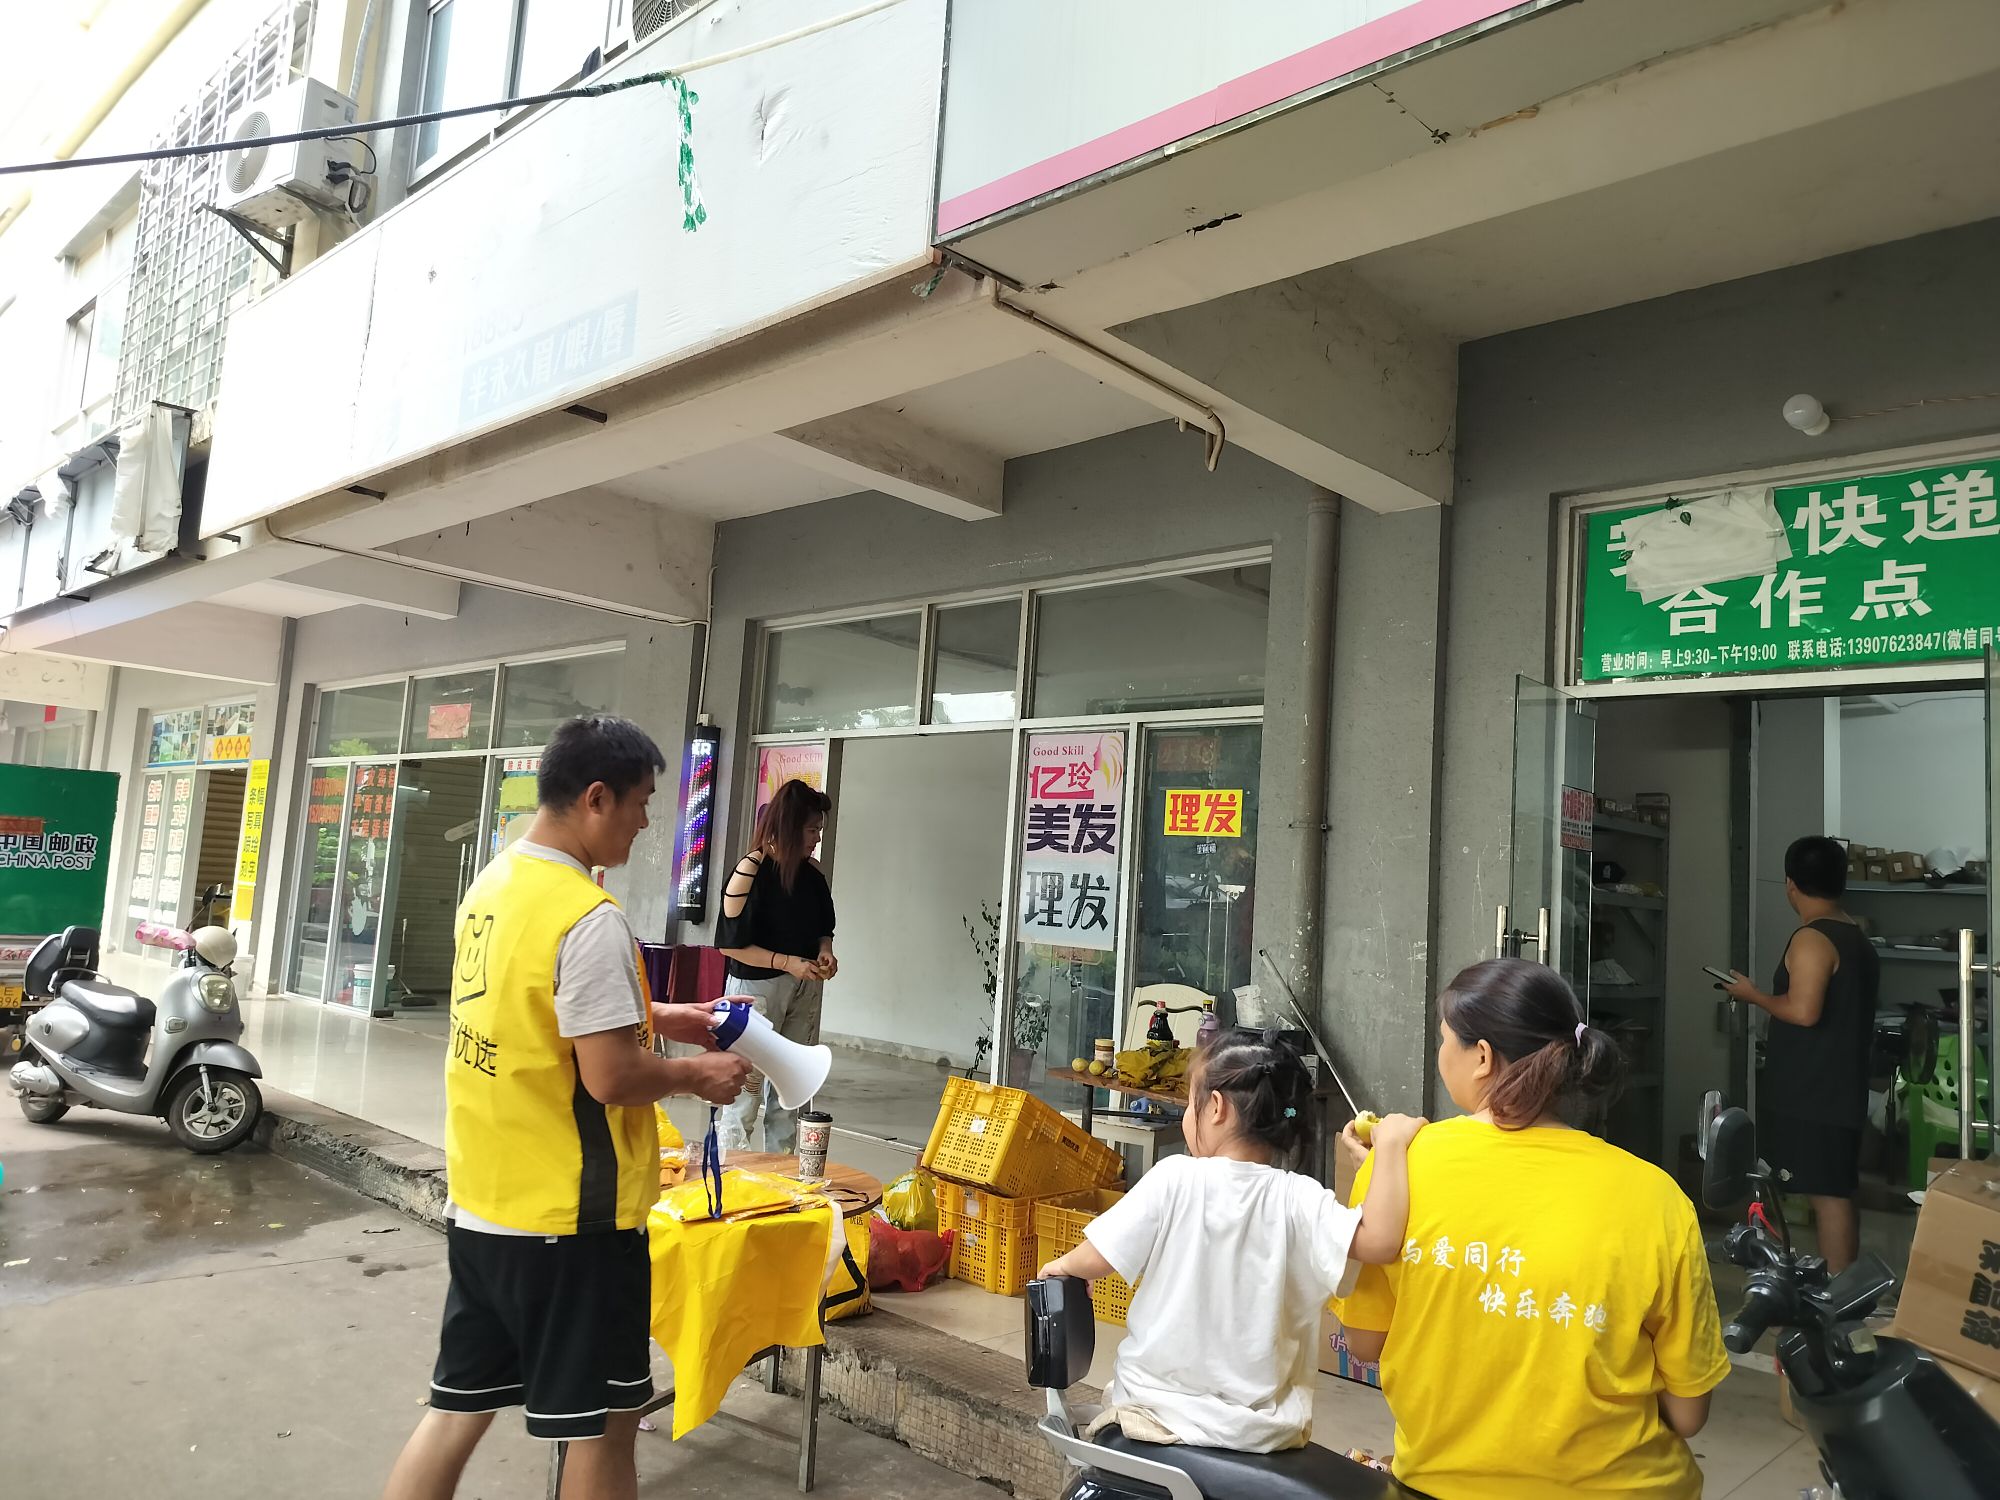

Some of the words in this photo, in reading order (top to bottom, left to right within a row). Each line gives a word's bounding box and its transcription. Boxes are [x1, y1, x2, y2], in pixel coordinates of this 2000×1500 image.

[1658, 559, 1933, 637] 合作点
[1033, 745, 1059, 757] Good
[1061, 744, 1084, 756] Skill
[1029, 761, 1095, 799] 亿玲
[1026, 803, 1117, 855] 美发
[1169, 793, 1238, 833] 理发
[0, 832, 97, 854] 中国邮政
[52, 854, 94, 869] POST
[1024, 871, 1110, 932] 理发
[452, 1013, 498, 1077] 优选
[1402, 1235, 1526, 1278] 与爱同行
[1478, 1283, 1608, 1333] 快乐奔跑
